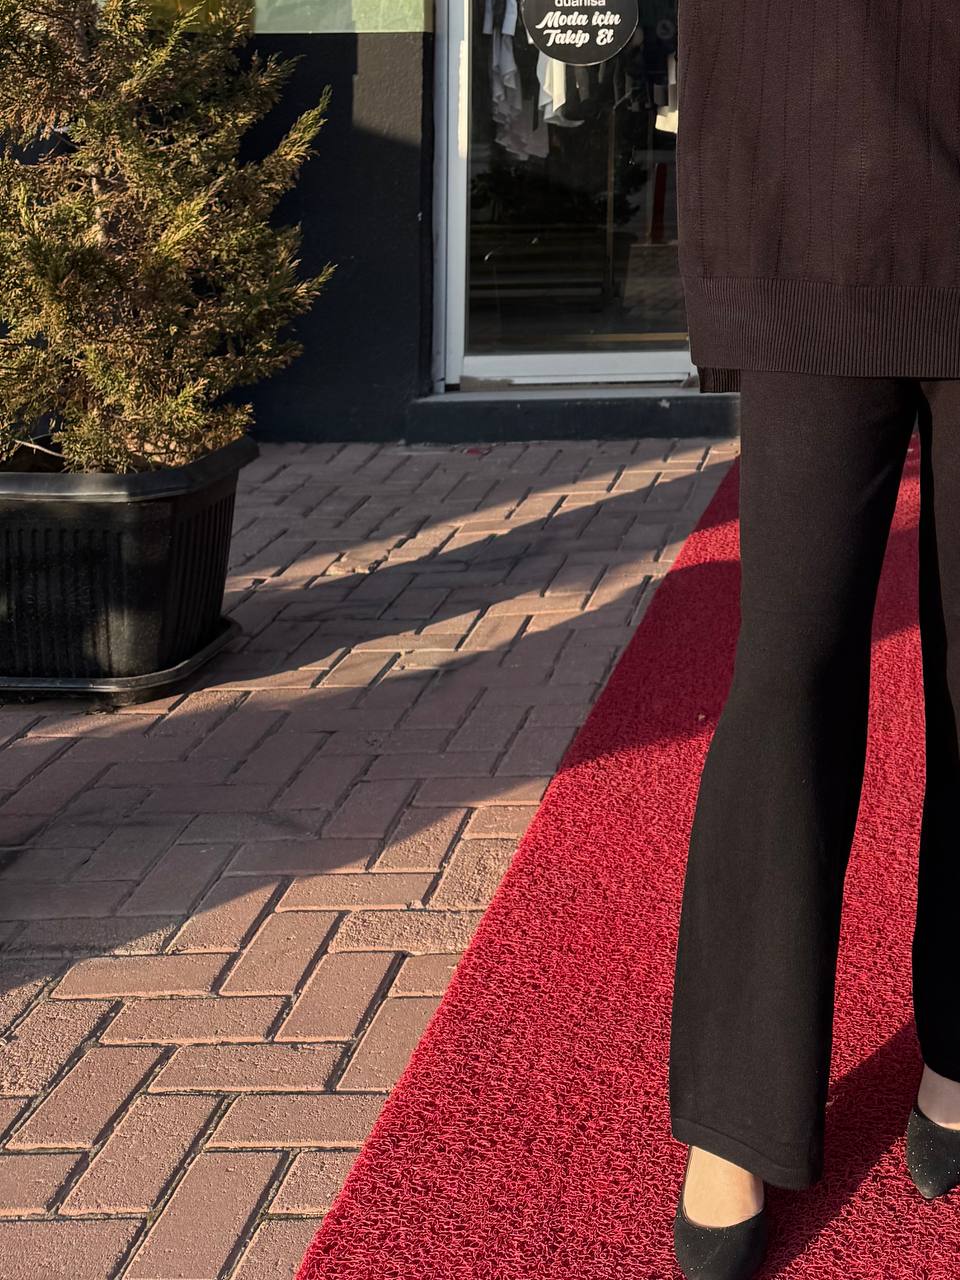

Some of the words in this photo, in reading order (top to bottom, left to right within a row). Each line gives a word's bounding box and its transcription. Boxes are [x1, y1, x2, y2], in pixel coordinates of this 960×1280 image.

[535, 11, 589, 29] Moda
[543, 29, 590, 48] Takip
[596, 28, 614, 46] Et
